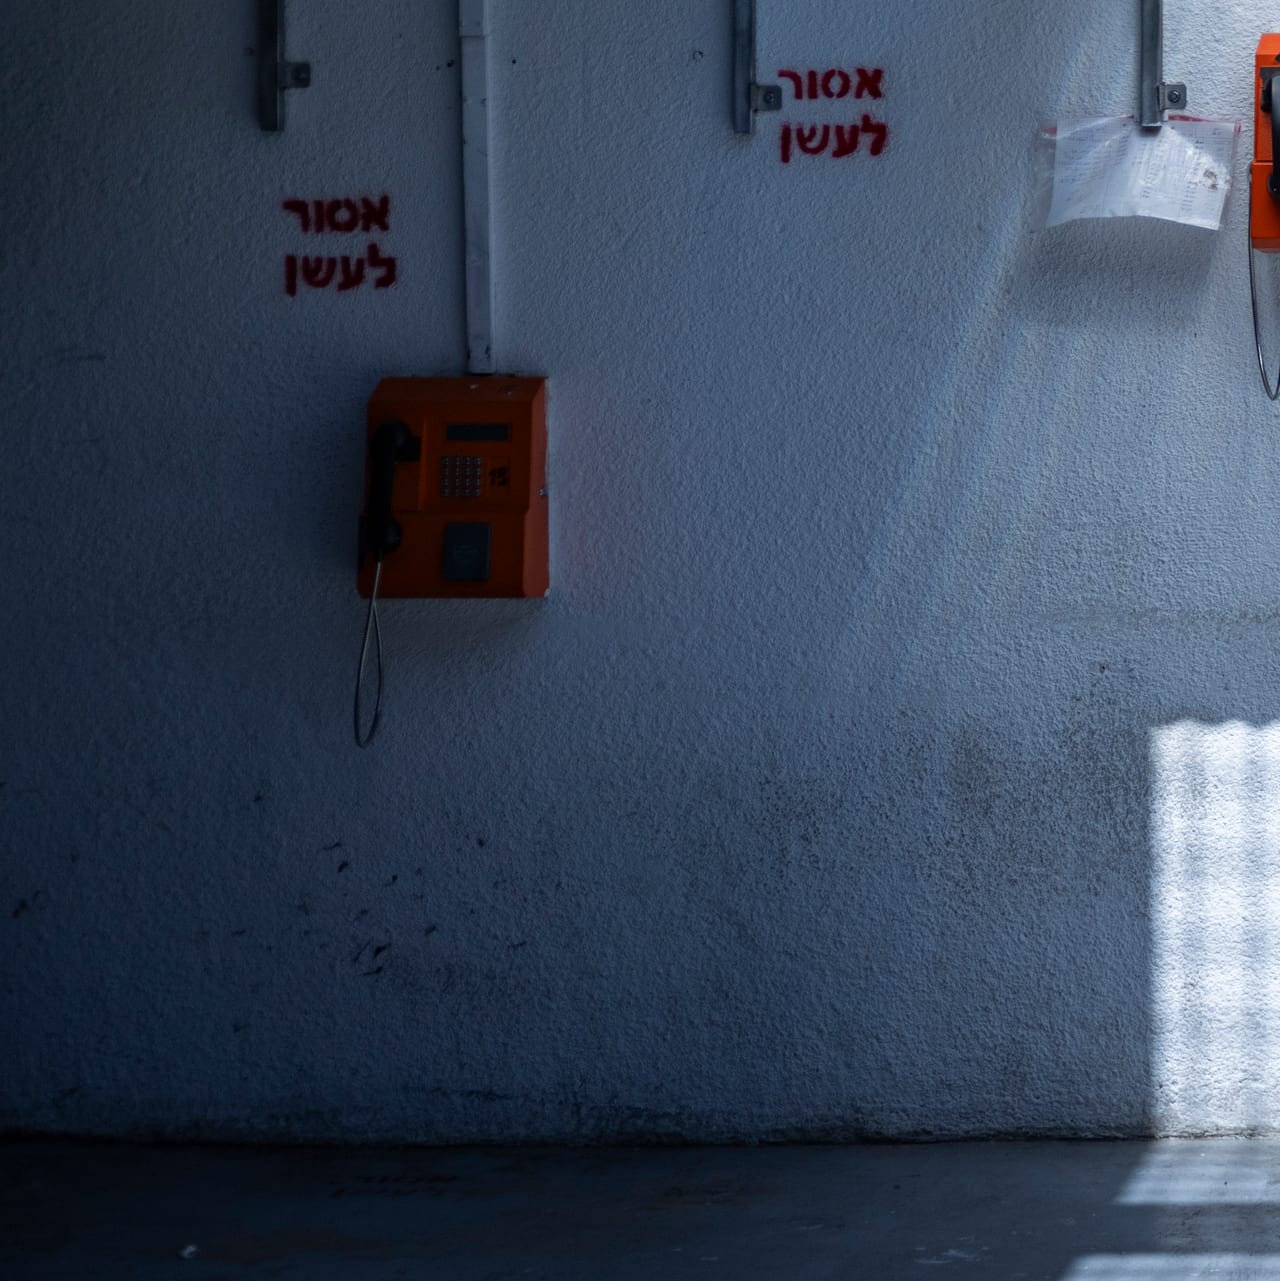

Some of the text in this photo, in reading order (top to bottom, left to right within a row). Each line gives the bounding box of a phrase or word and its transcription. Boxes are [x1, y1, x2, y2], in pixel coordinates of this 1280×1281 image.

[777, 67, 884, 100] אסור
[780, 113, 889, 165] לעשן
[280, 193, 391, 234] אסור
[284, 242, 398, 298] לעשן
